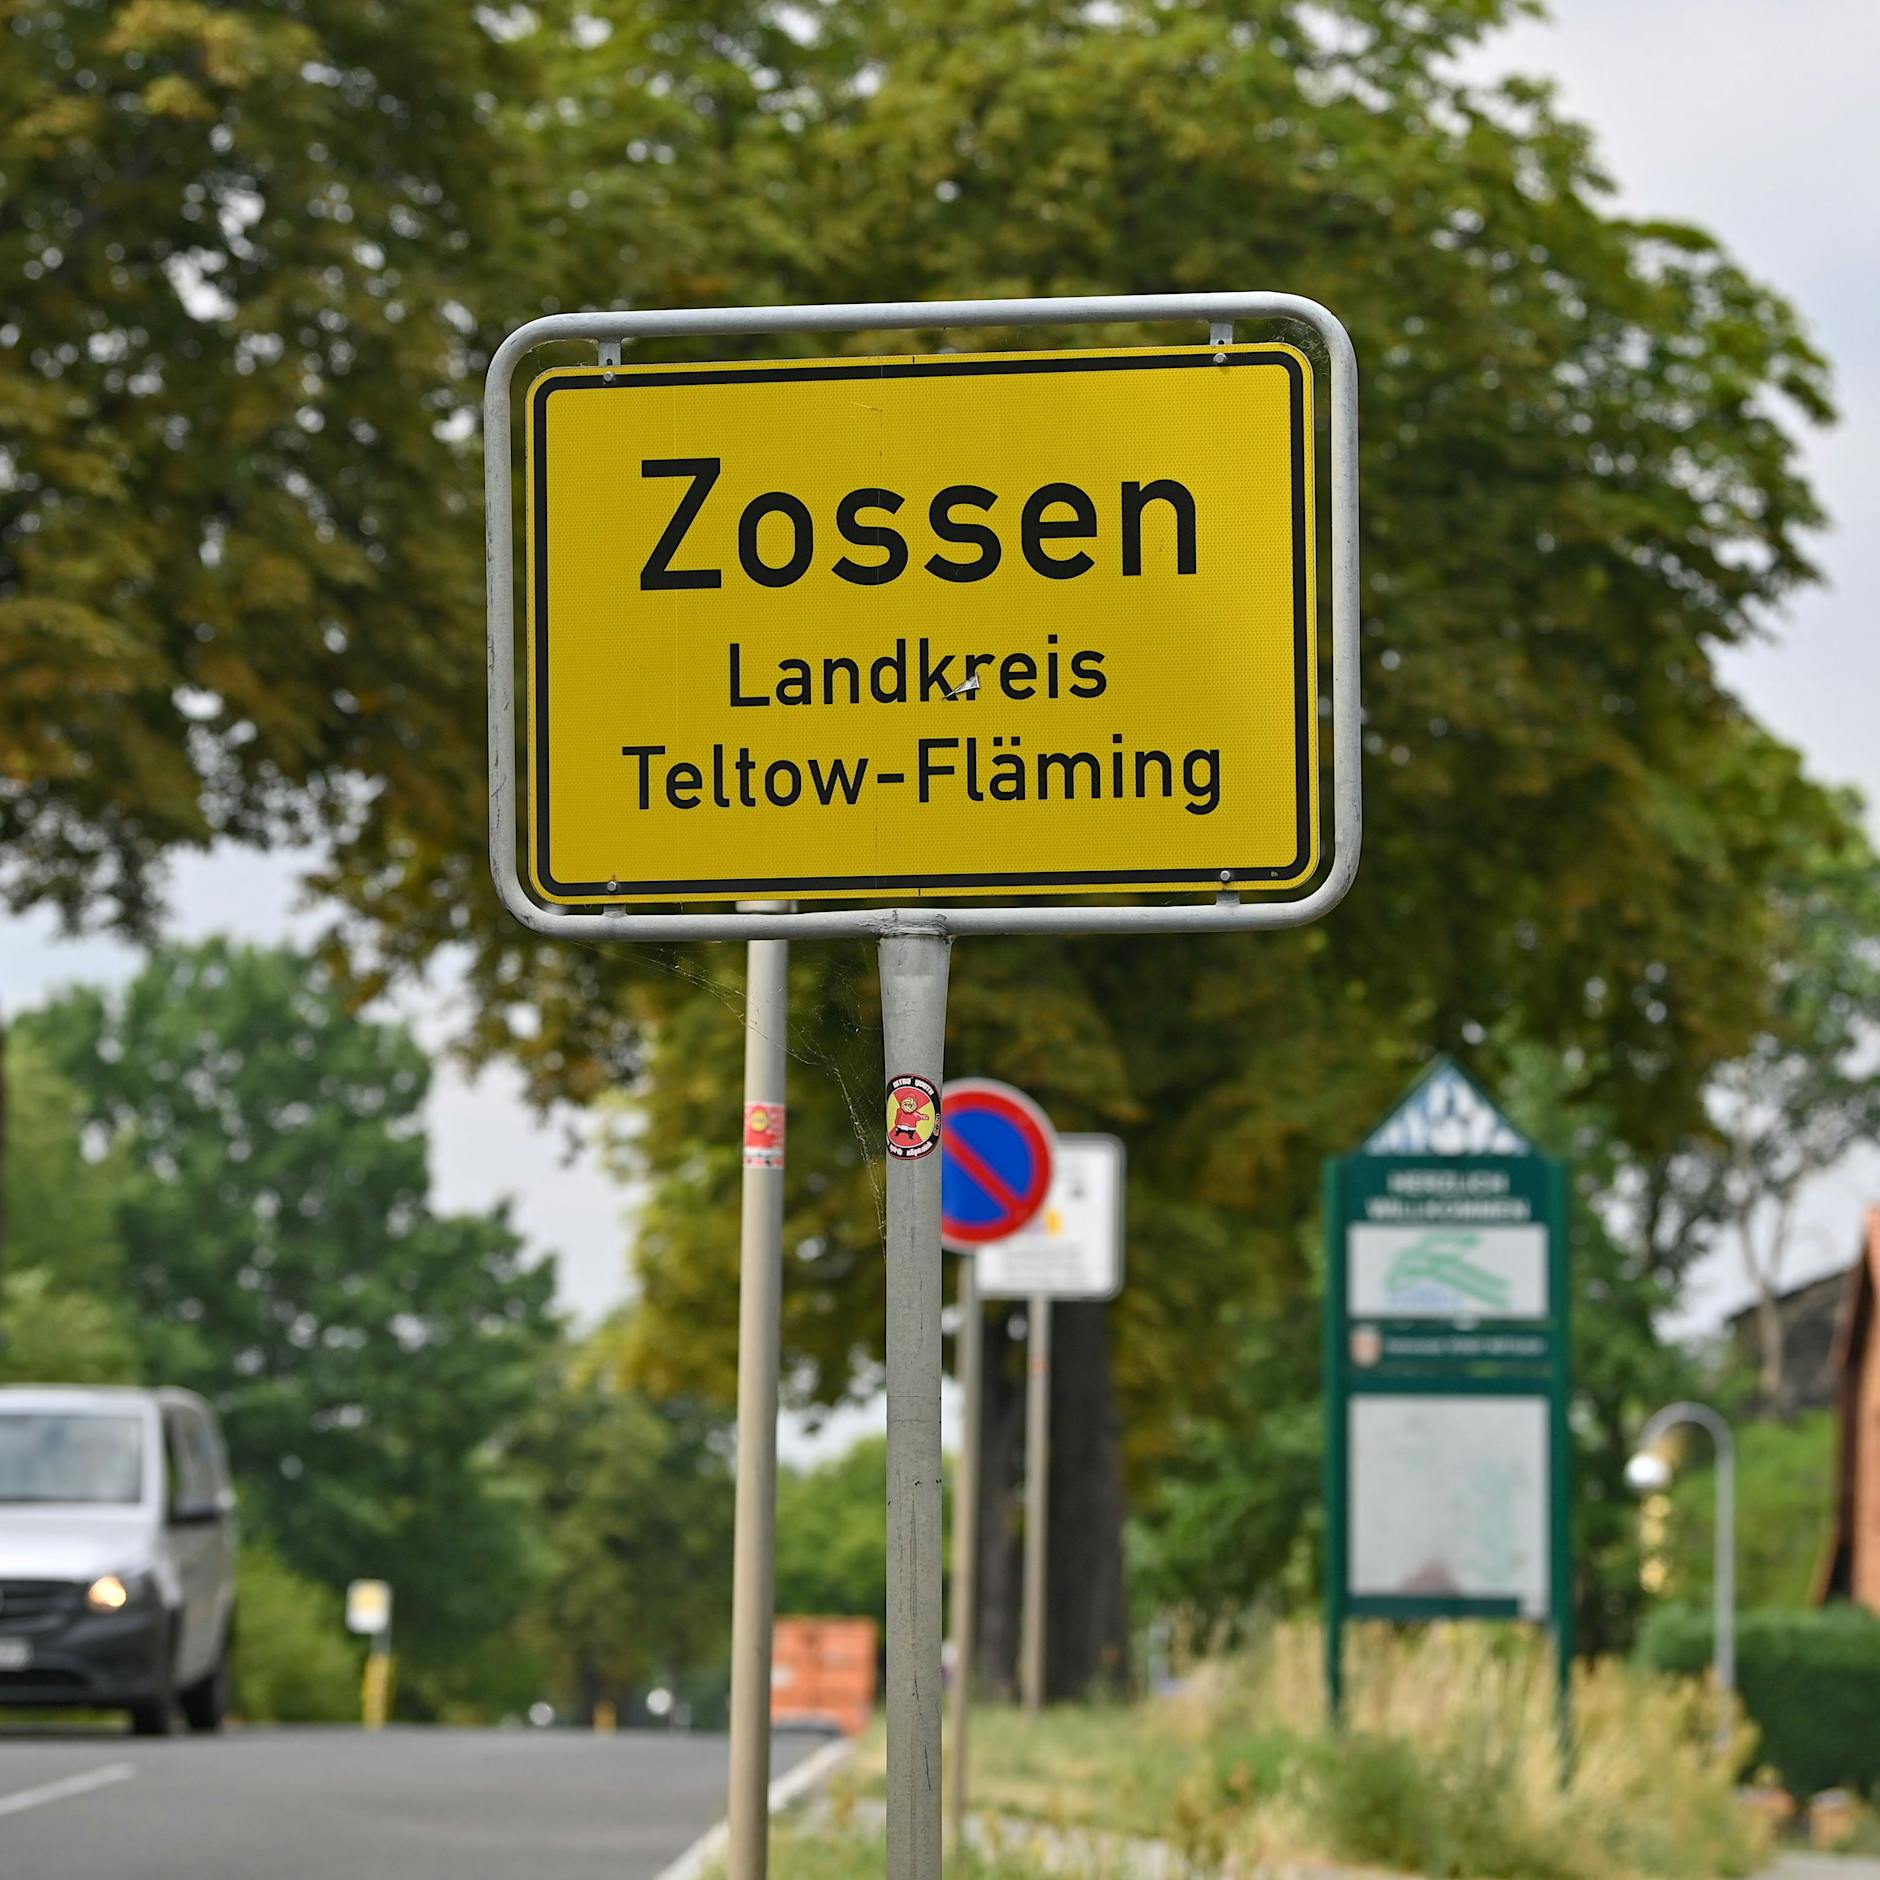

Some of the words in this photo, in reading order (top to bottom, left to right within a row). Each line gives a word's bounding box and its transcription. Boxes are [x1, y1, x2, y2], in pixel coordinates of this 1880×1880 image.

[640, 457, 1197, 591] Zossen
[729, 634, 1107, 708] Landkreis
[621, 733, 1220, 816] Teltow-Fläming
